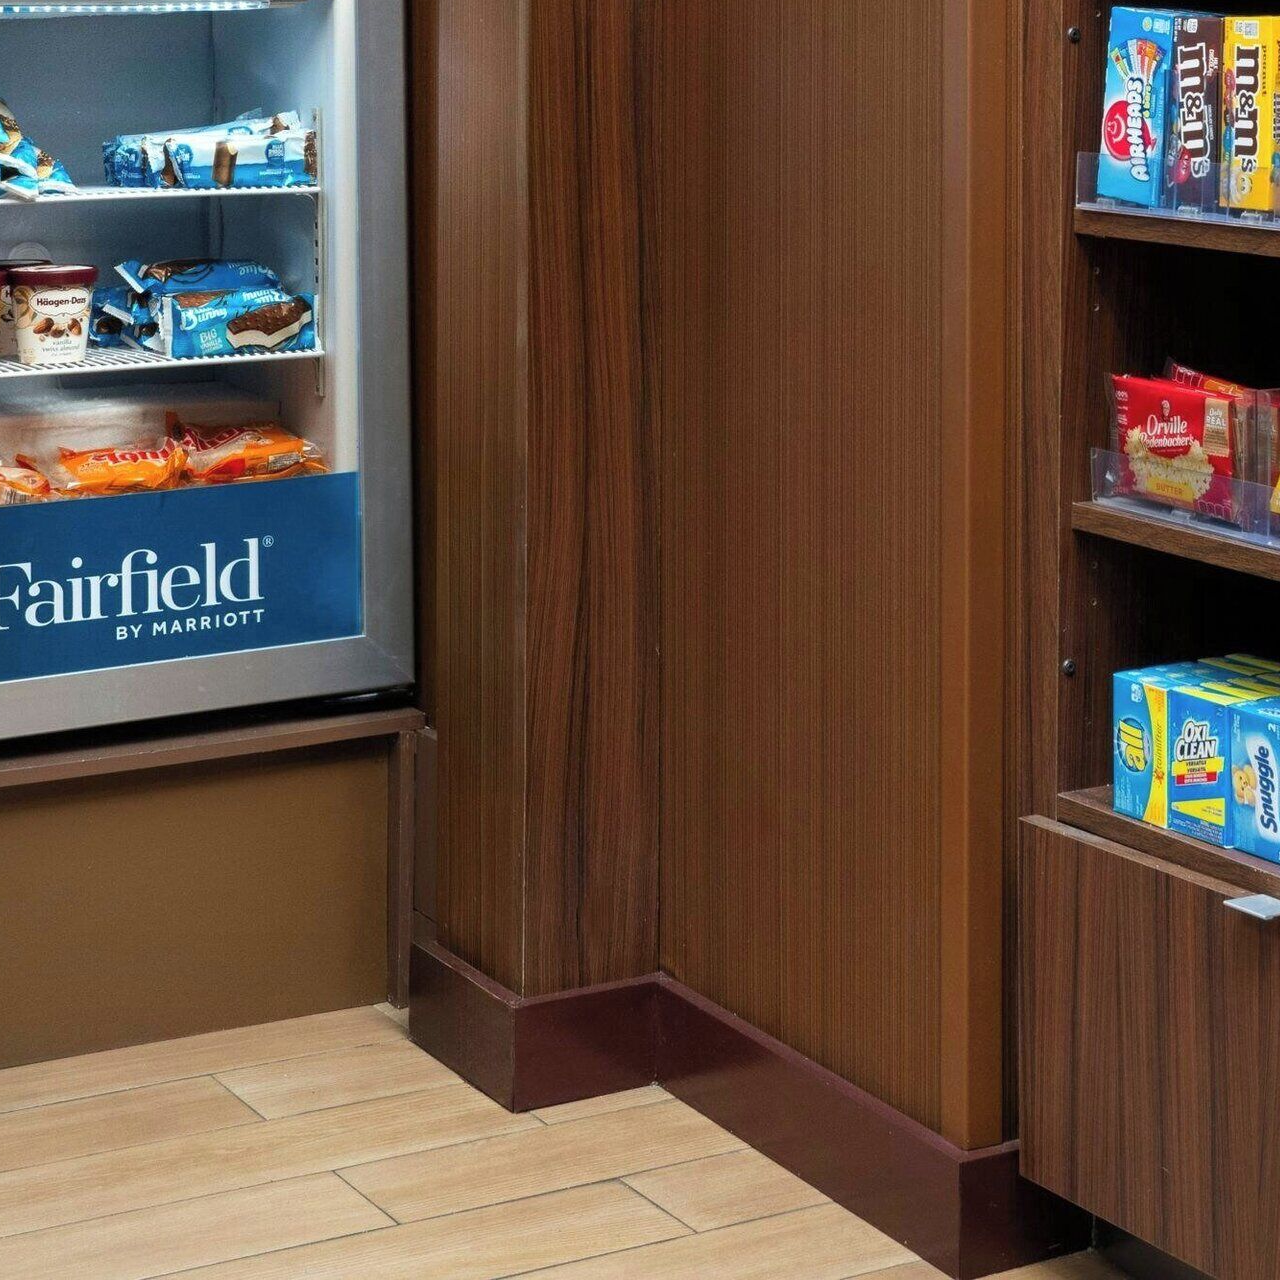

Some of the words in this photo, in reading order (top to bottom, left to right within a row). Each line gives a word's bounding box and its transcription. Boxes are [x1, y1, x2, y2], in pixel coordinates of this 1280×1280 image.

[1127, 76, 1151, 182] AIRHEADS
[37, 297, 87, 308] Häagen-Dazs
[1146, 415, 1188, 435] Orville
[116, 624, 141, 640] BY
[152, 609, 265, 637] MARRIOTT
[1184, 721, 1208, 742] OXI
[1175, 739, 1217, 762] CLEAN
[1254, 745, 1278, 834] Snuggle
